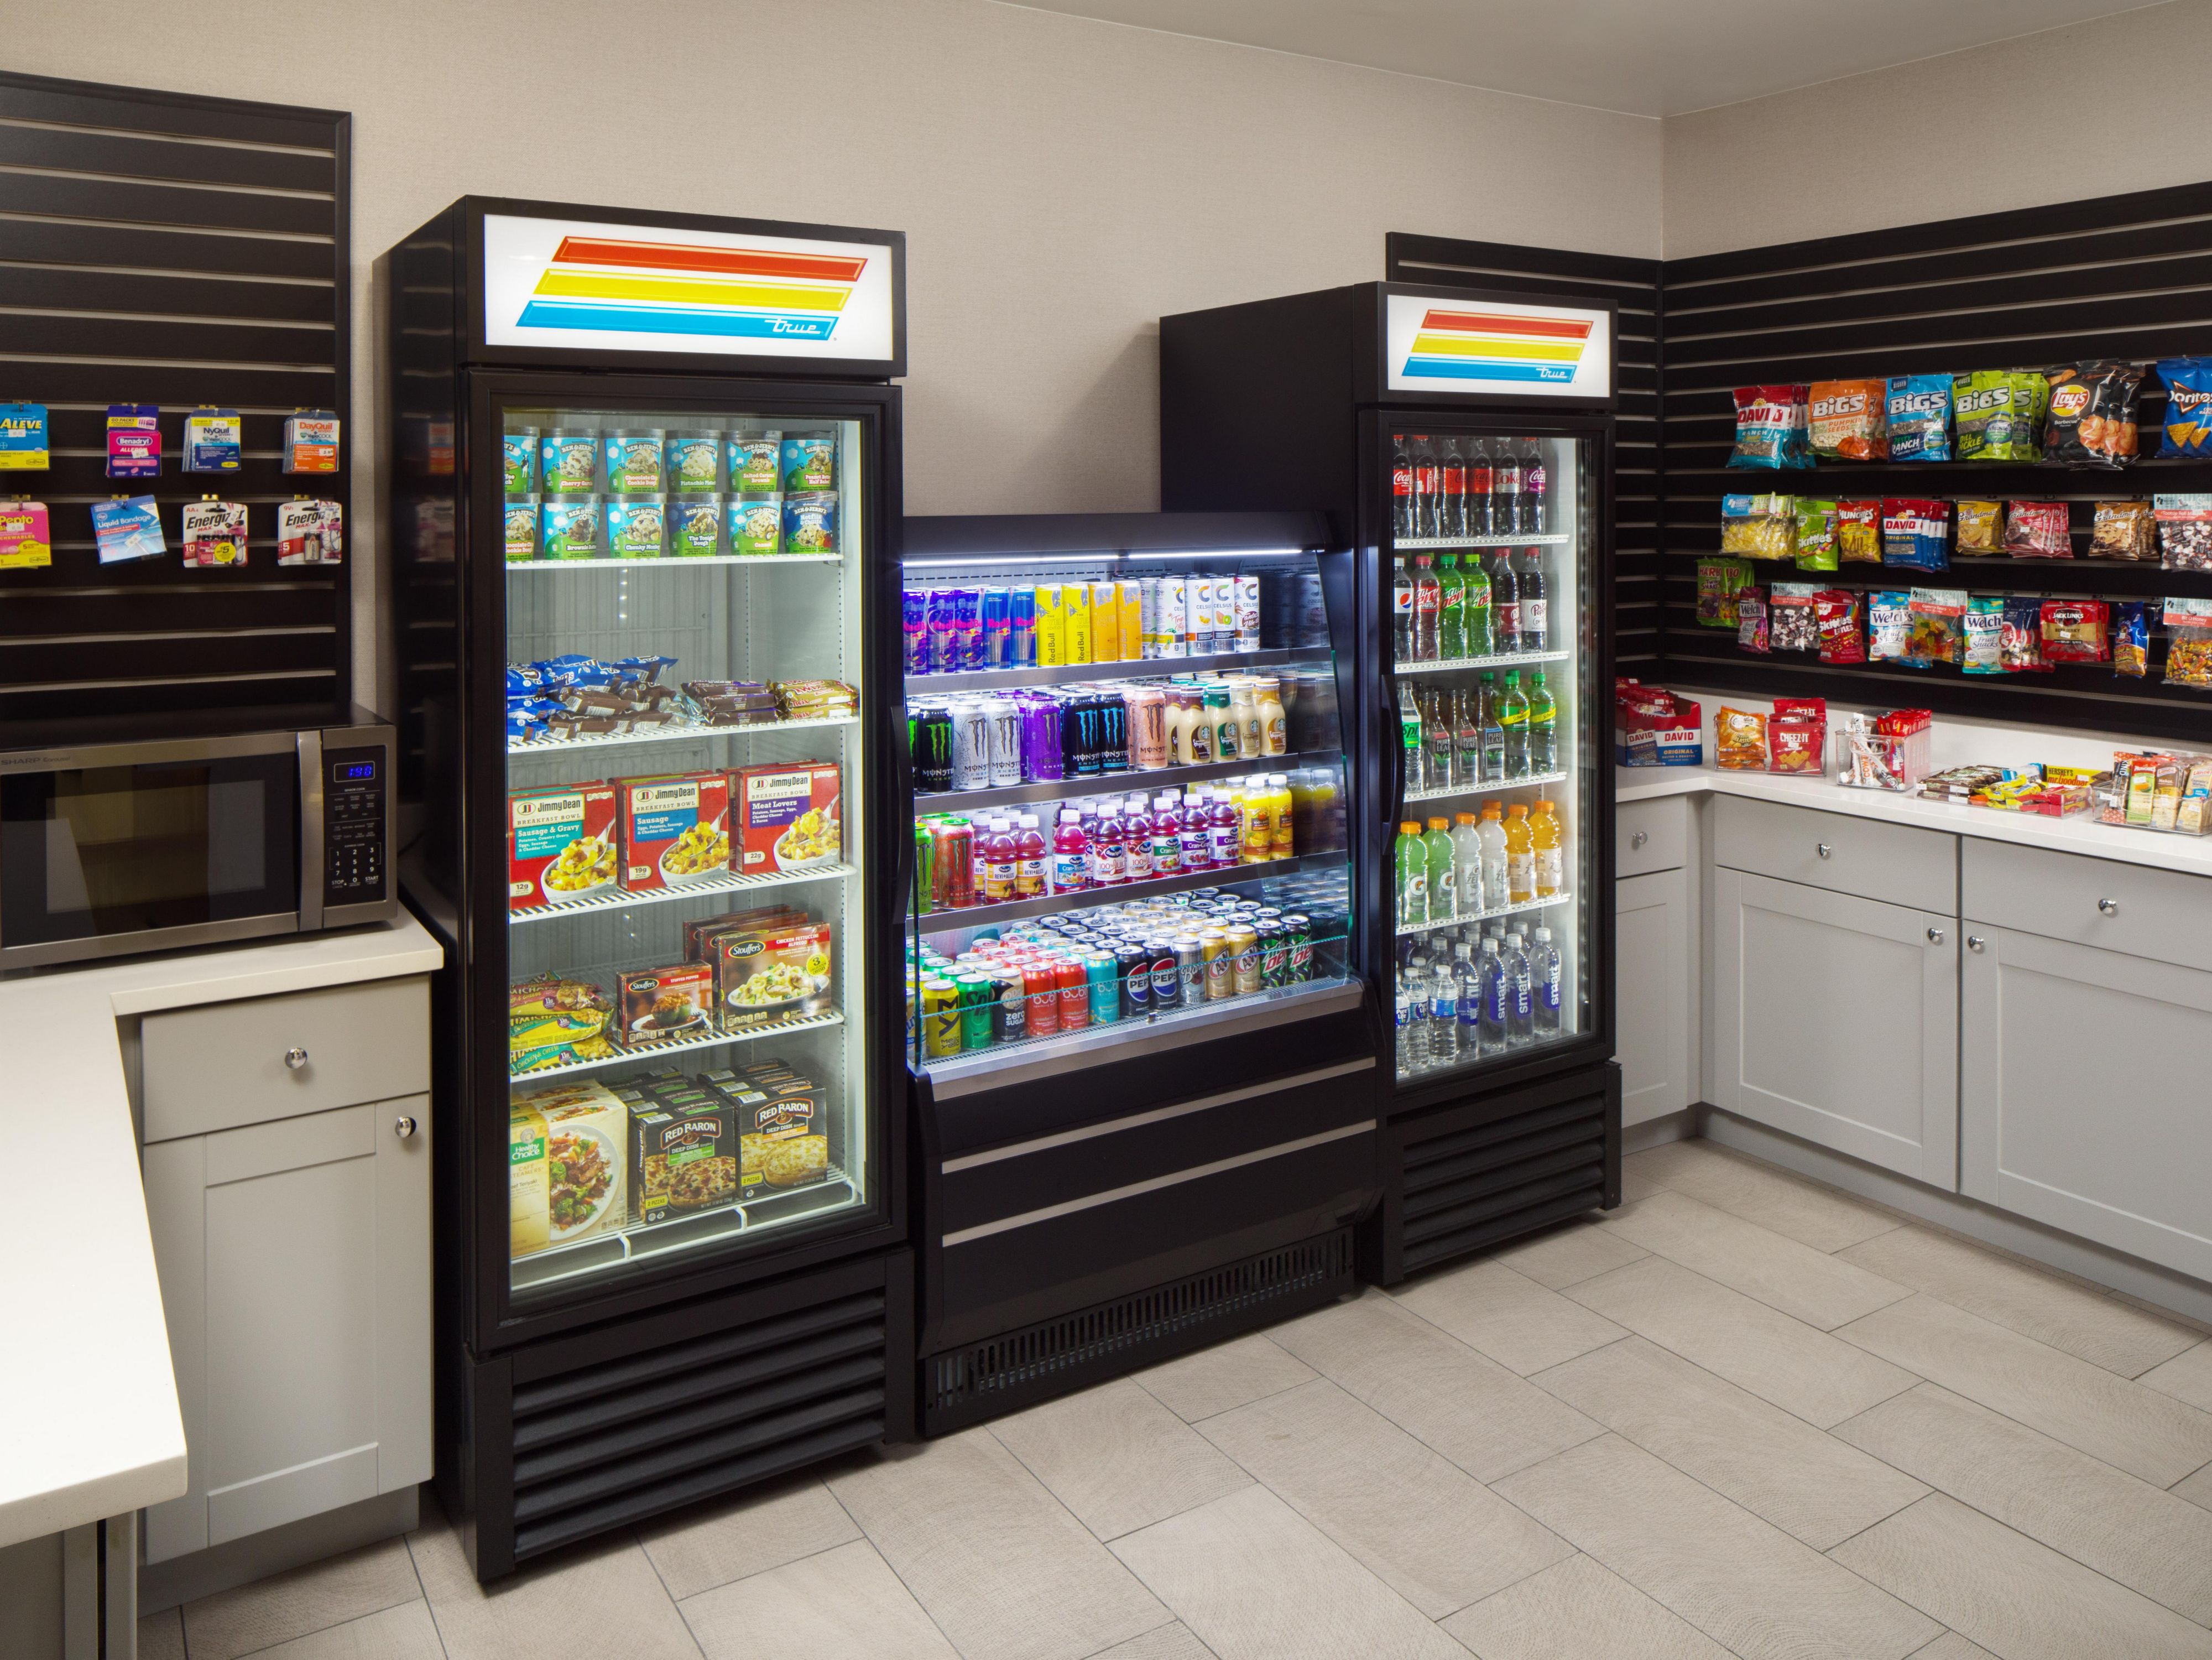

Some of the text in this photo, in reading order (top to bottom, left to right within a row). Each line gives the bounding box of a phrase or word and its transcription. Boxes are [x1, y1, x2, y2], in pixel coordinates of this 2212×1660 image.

[764, 318, 821, 334] true
[1536, 367, 1567, 379] true
[2053, 391, 2086, 409] Lay's
[1738, 408, 1783, 423] DAVID
[300, 422, 333, 430] DayQuil
[1829, 418, 1863, 427] PUMPKIN
[119, 438, 150, 446] Benadryl
[121, 514, 152, 524] Bandage
[1839, 508, 1874, 520] MUNCHIES
[1885, 521, 1916, 529] DAVID
[282, 542, 290, 551] 5
[1629, 732, 1653, 742] DAVID
[1665, 732, 1694, 742] DAVID
[2048, 767, 2074, 776] HERSHEY'S
[770, 778, 792, 788] Jimmy
[655, 788, 696, 800] Jimmy Dean
[538, 800, 581, 813] Jimmy Dean
[637, 803, 675, 812] BREAKFAST
[517, 816, 559, 825] BREAKFAST
[637, 816, 669, 825] Sausage
[518, 829, 548, 837] Sausage
[733, 943, 761, 955] Stouffer's
[632, 980, 658, 990] Stouffer's
[1549, 965, 1559, 1006] smart
[1517, 972, 1527, 1014] smart
[1496, 979, 1505, 1019] smart
[759, 1102, 809, 1122] RED BARON
[665, 1122, 716, 1143] RED BARON
[516, 1143, 539, 1153] Healthy
[512, 1148, 540, 1161] Choice
